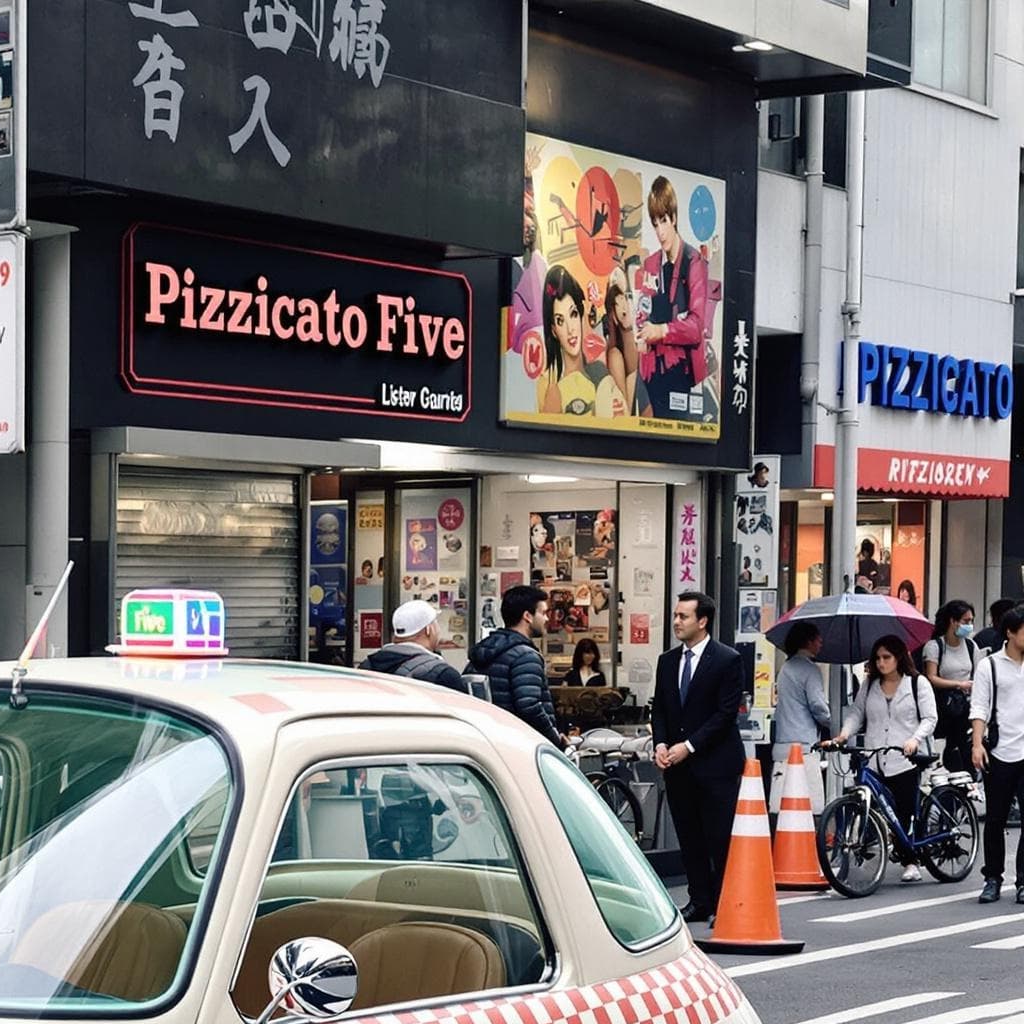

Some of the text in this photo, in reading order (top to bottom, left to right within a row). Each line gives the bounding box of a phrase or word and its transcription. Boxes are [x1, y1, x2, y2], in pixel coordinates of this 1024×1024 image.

[144, 262, 465, 360] Pizzicato Five
[857, 341, 1014, 421] PIZZICATO
